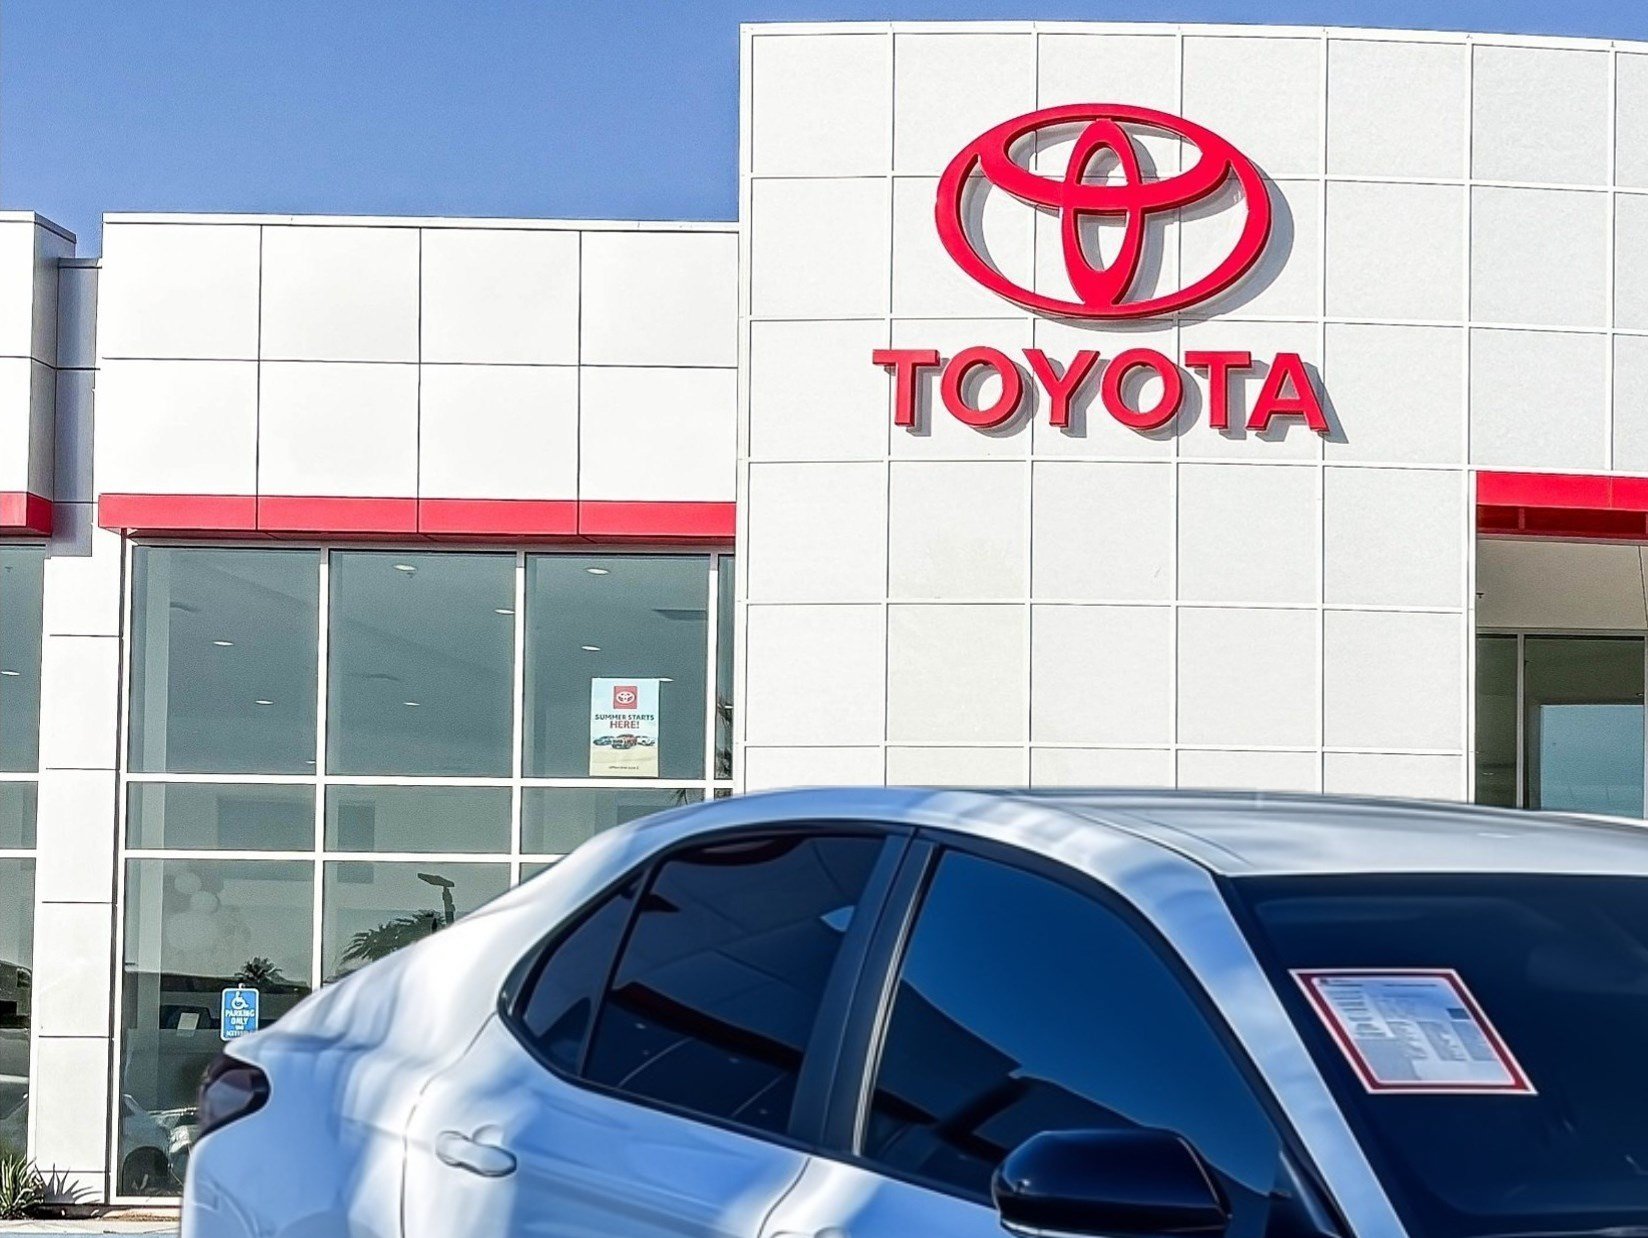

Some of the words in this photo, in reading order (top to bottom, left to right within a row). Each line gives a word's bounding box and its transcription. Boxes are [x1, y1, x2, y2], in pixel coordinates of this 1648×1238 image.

[872, 346, 1330, 433] TOYOTA
[609, 720, 640, 729] HERE!
[225, 1009, 255, 1017] PARKING
